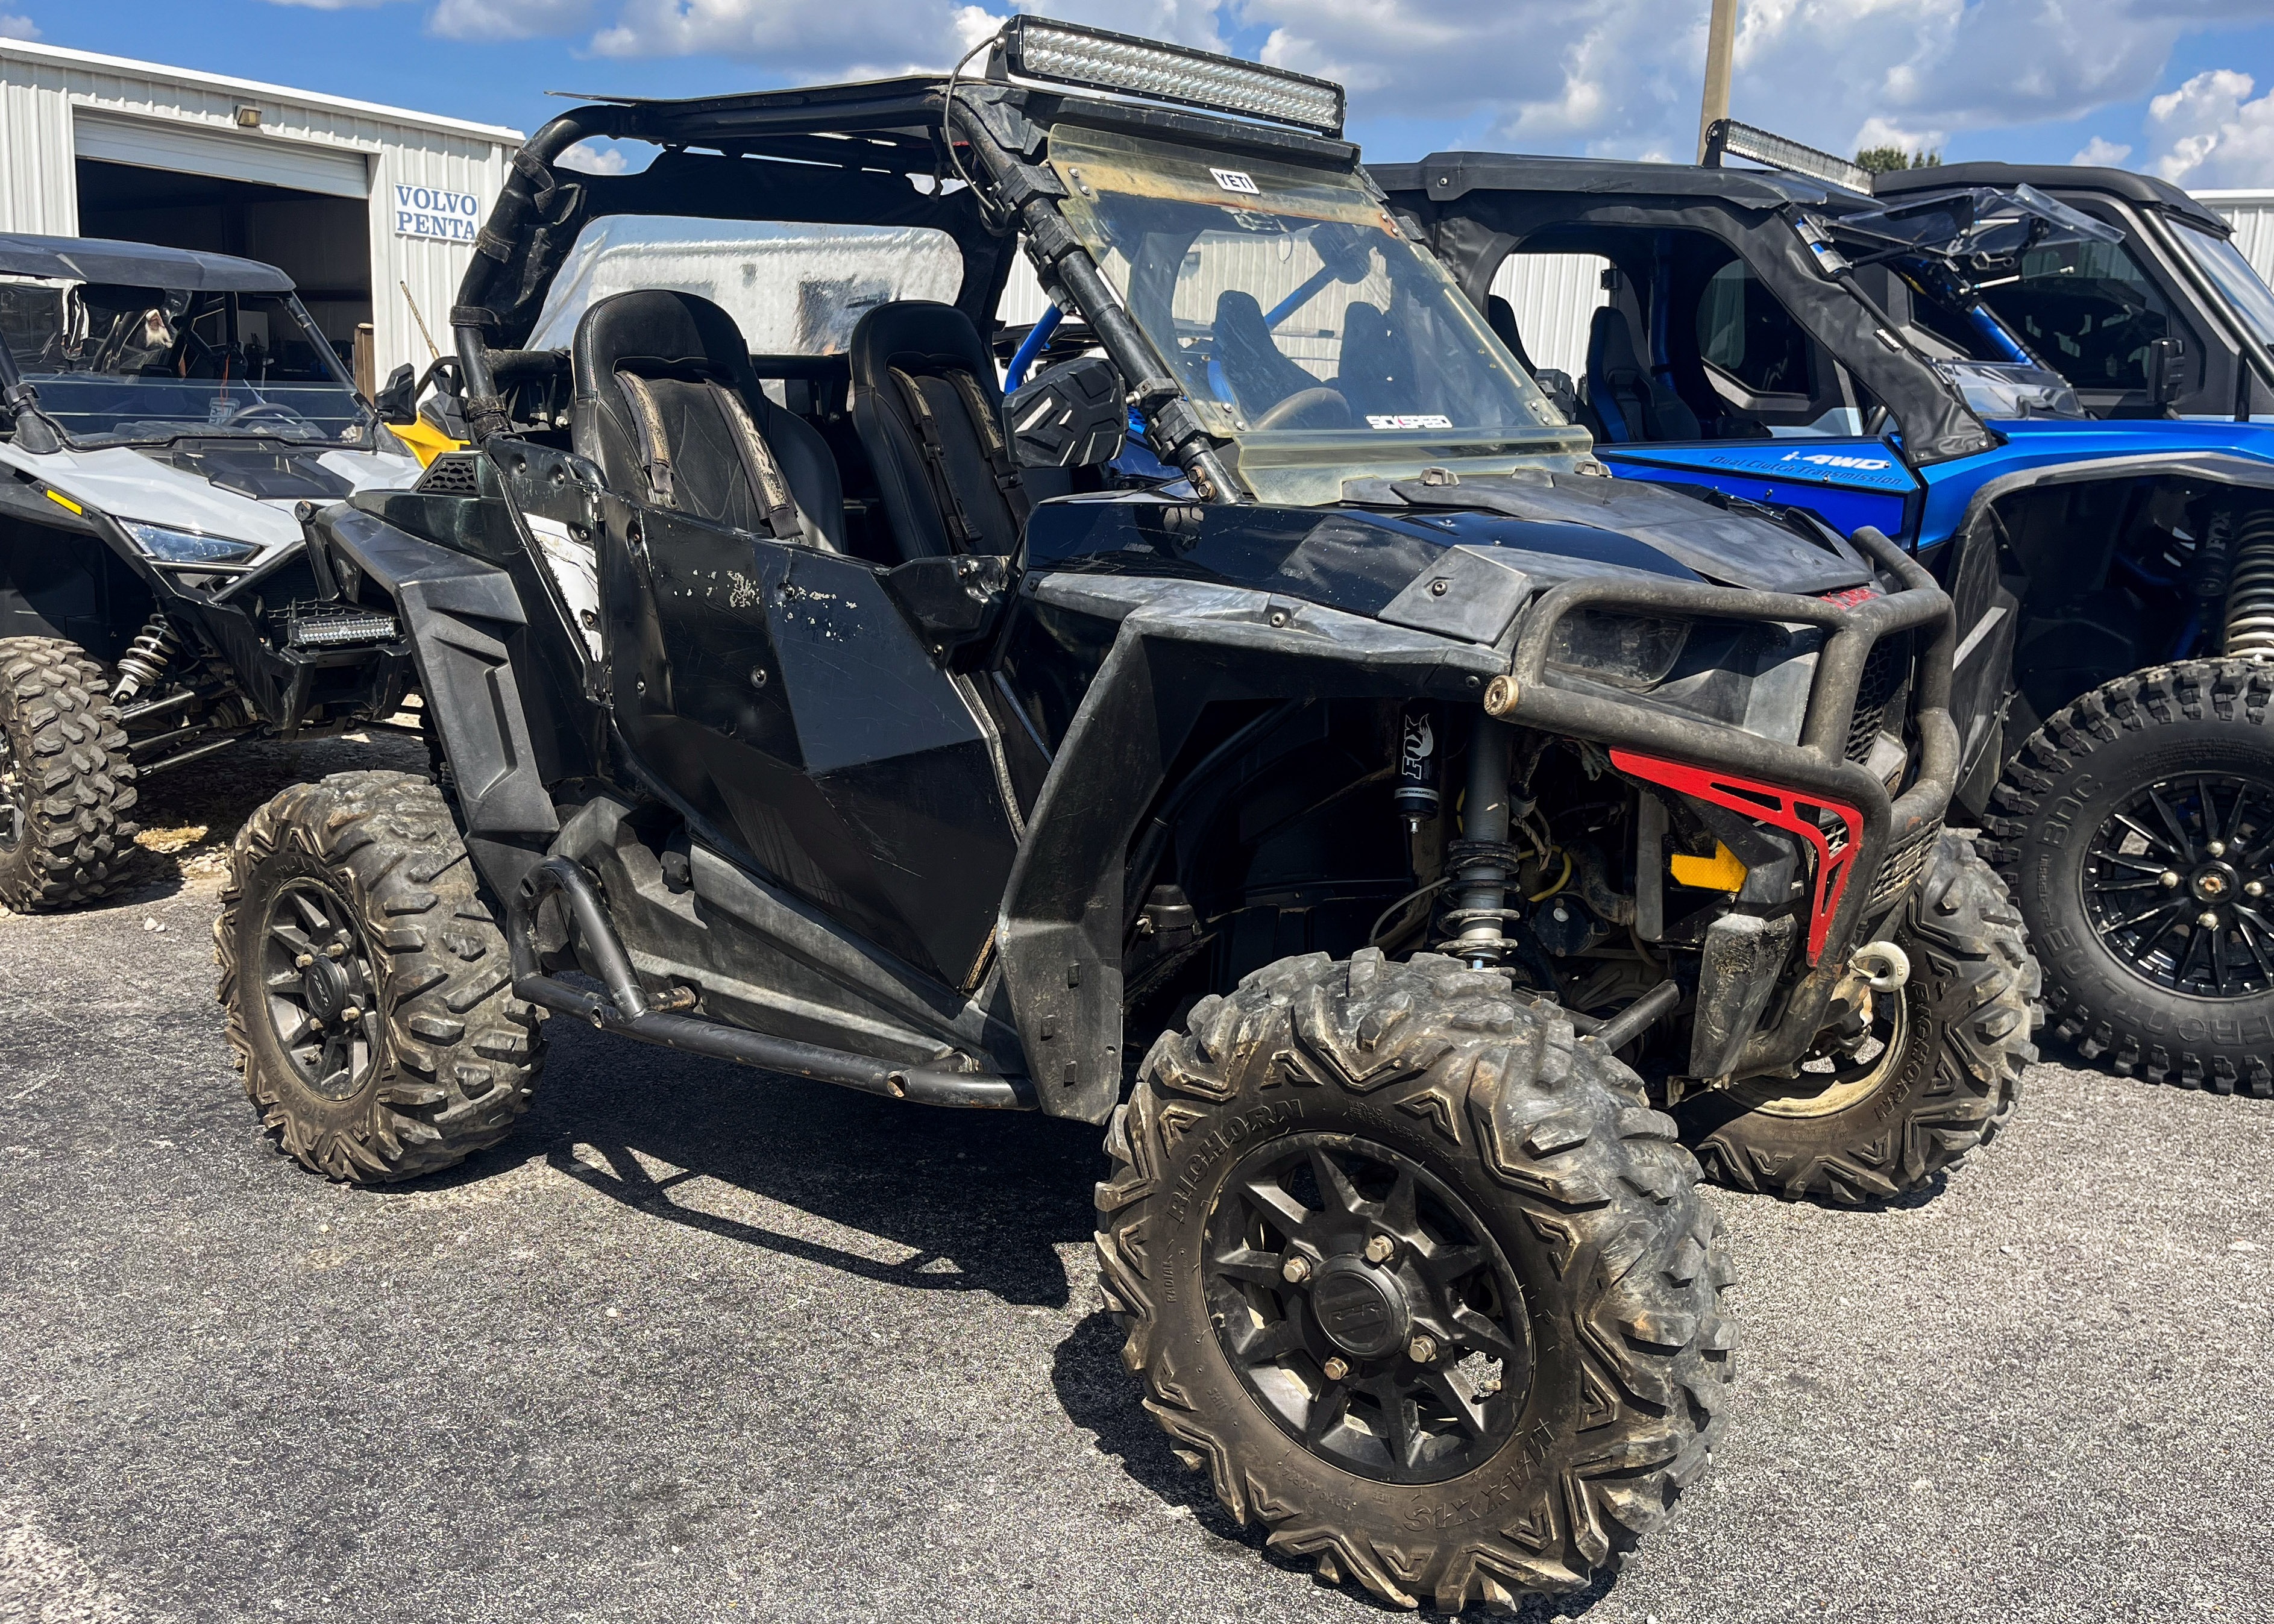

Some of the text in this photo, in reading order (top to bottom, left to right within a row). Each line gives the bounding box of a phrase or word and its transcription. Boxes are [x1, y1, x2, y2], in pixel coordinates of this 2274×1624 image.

[395, 185, 477, 216] VOLVO
[1214, 172, 1254, 189] YETI
[397, 211, 476, 240] PENTA
[740, 412, 775, 475] RZR
[1780, 451, 1891, 470] i-4WD
[1709, 456, 1903, 486] Dual Clutch Transmission
[1402, 713, 1431, 780] FOX
[2036, 774, 2103, 849] BDC
[1167, 1099, 1304, 1226] BIGHORN
[1162, 1260, 1177, 1303] RADIAL
[1403, 1418, 1554, 1532] MAXXIS
